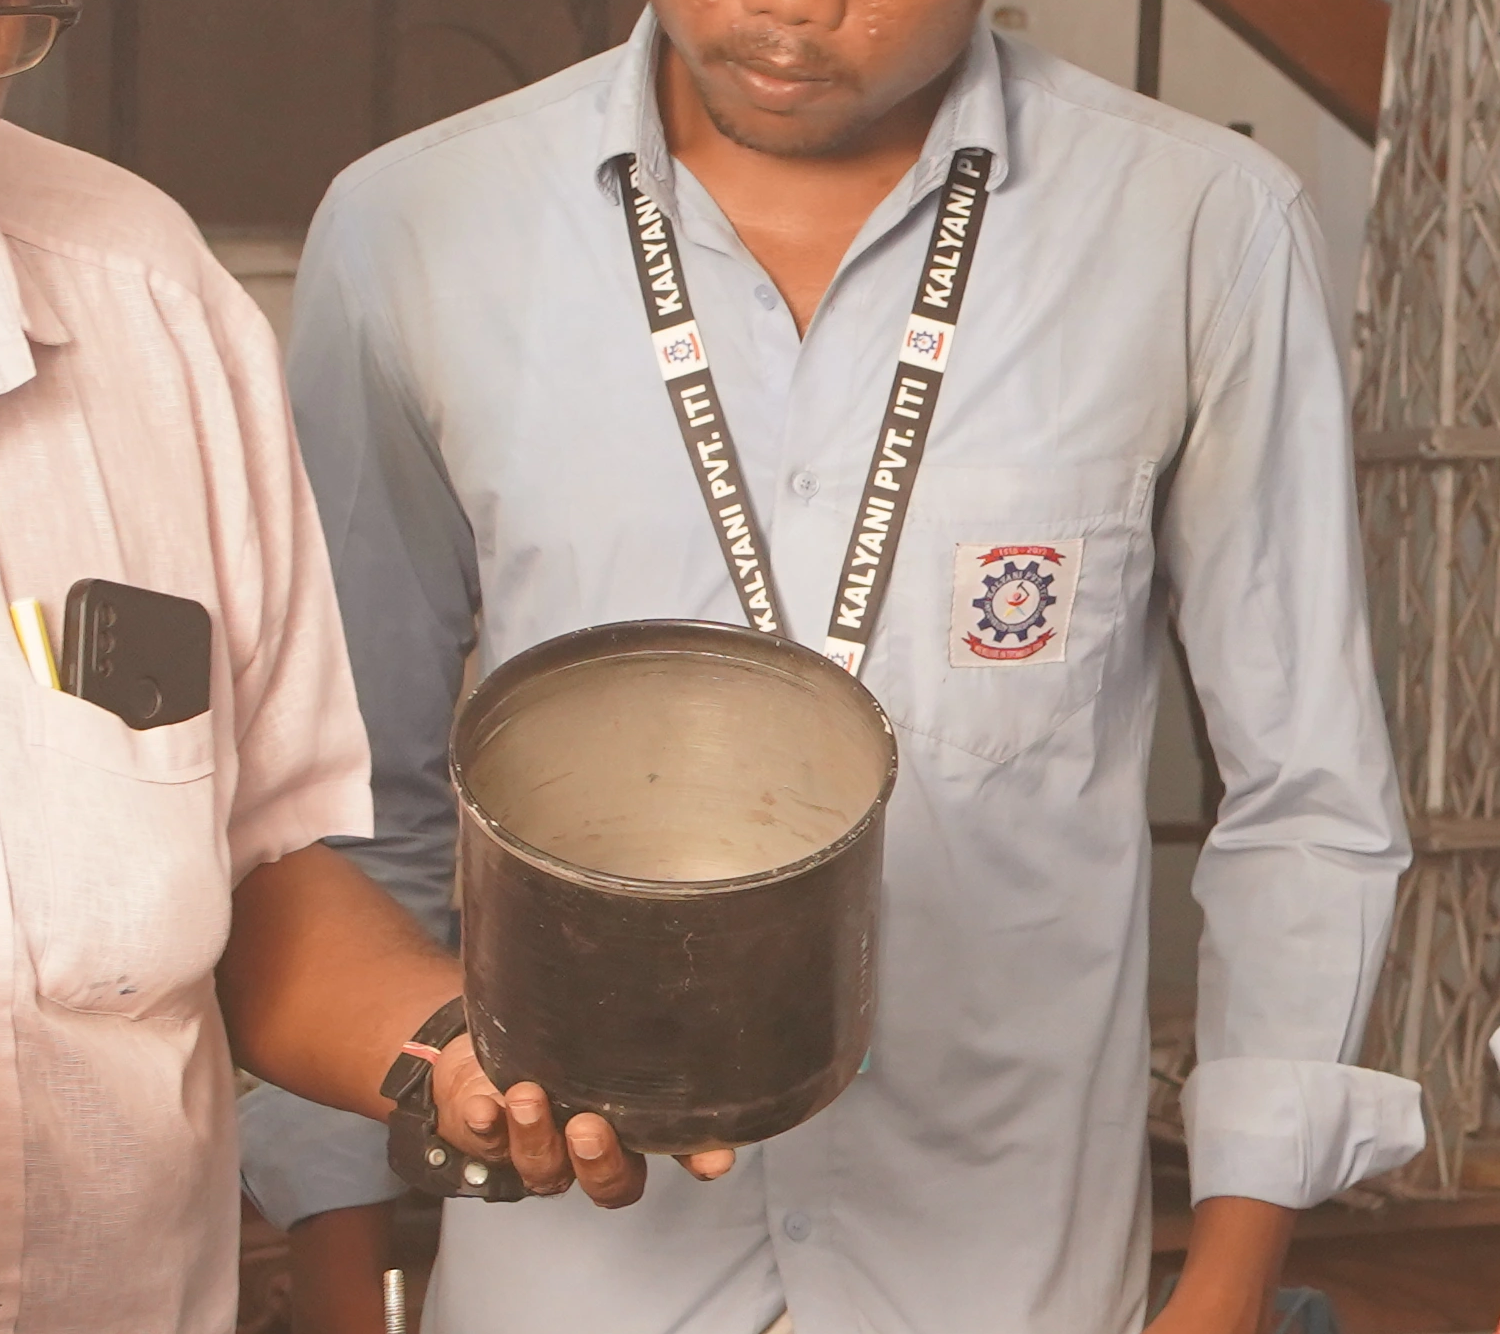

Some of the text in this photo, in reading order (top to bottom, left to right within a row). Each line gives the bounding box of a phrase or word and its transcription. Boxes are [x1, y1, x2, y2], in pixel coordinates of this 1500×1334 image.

[633, 194, 683, 316] KALYANI
[922, 182, 977, 308] KALYANI
[680, 384, 778, 633] KALYANI PVT. ITI
[836, 377, 928, 628] KALYANI PVT. ITI
